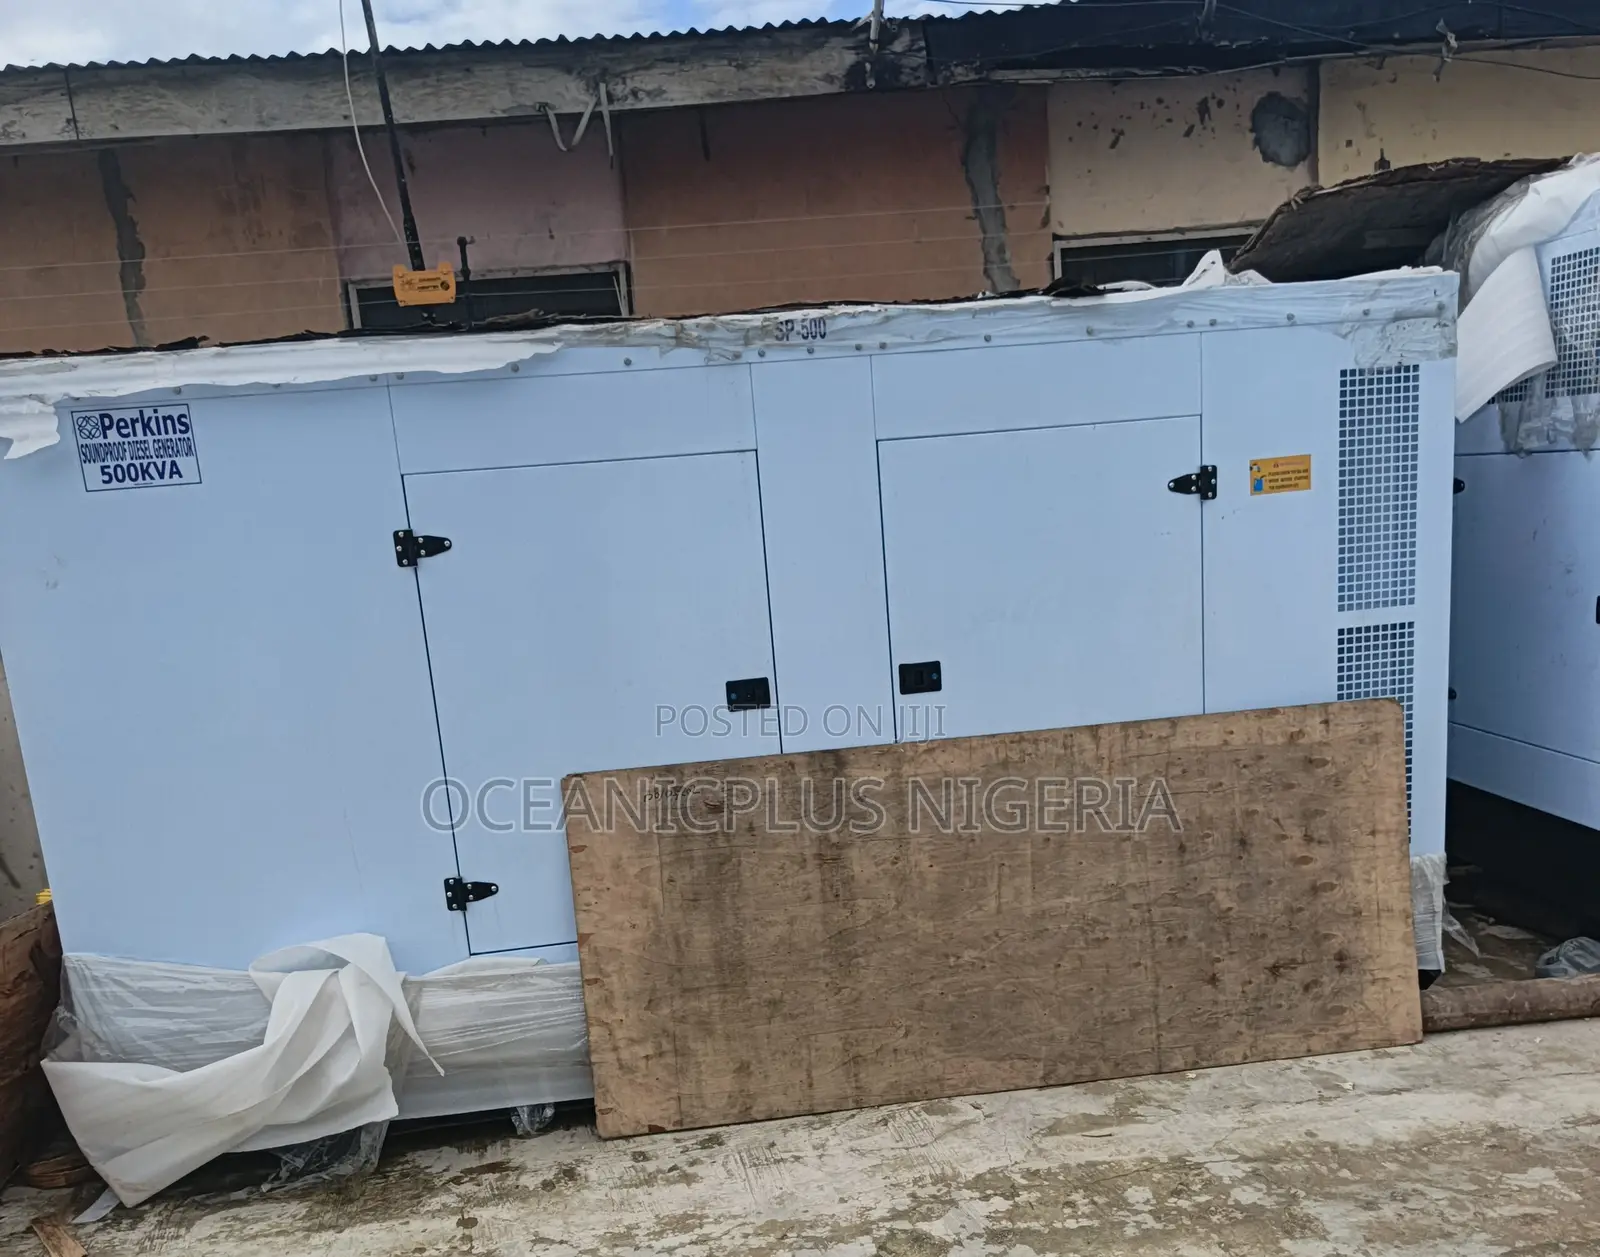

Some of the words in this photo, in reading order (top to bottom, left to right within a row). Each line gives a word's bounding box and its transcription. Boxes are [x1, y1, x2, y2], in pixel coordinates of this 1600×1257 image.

[775, 317, 826, 341] SP-500
[98, 408, 190, 439] Perkins
[80, 441, 127, 464] SOUNDPROOF
[127, 440, 153, 461] DIESEL
[152, 437, 194, 459] GENERATOR
[100, 460, 183, 485] 500KVA
